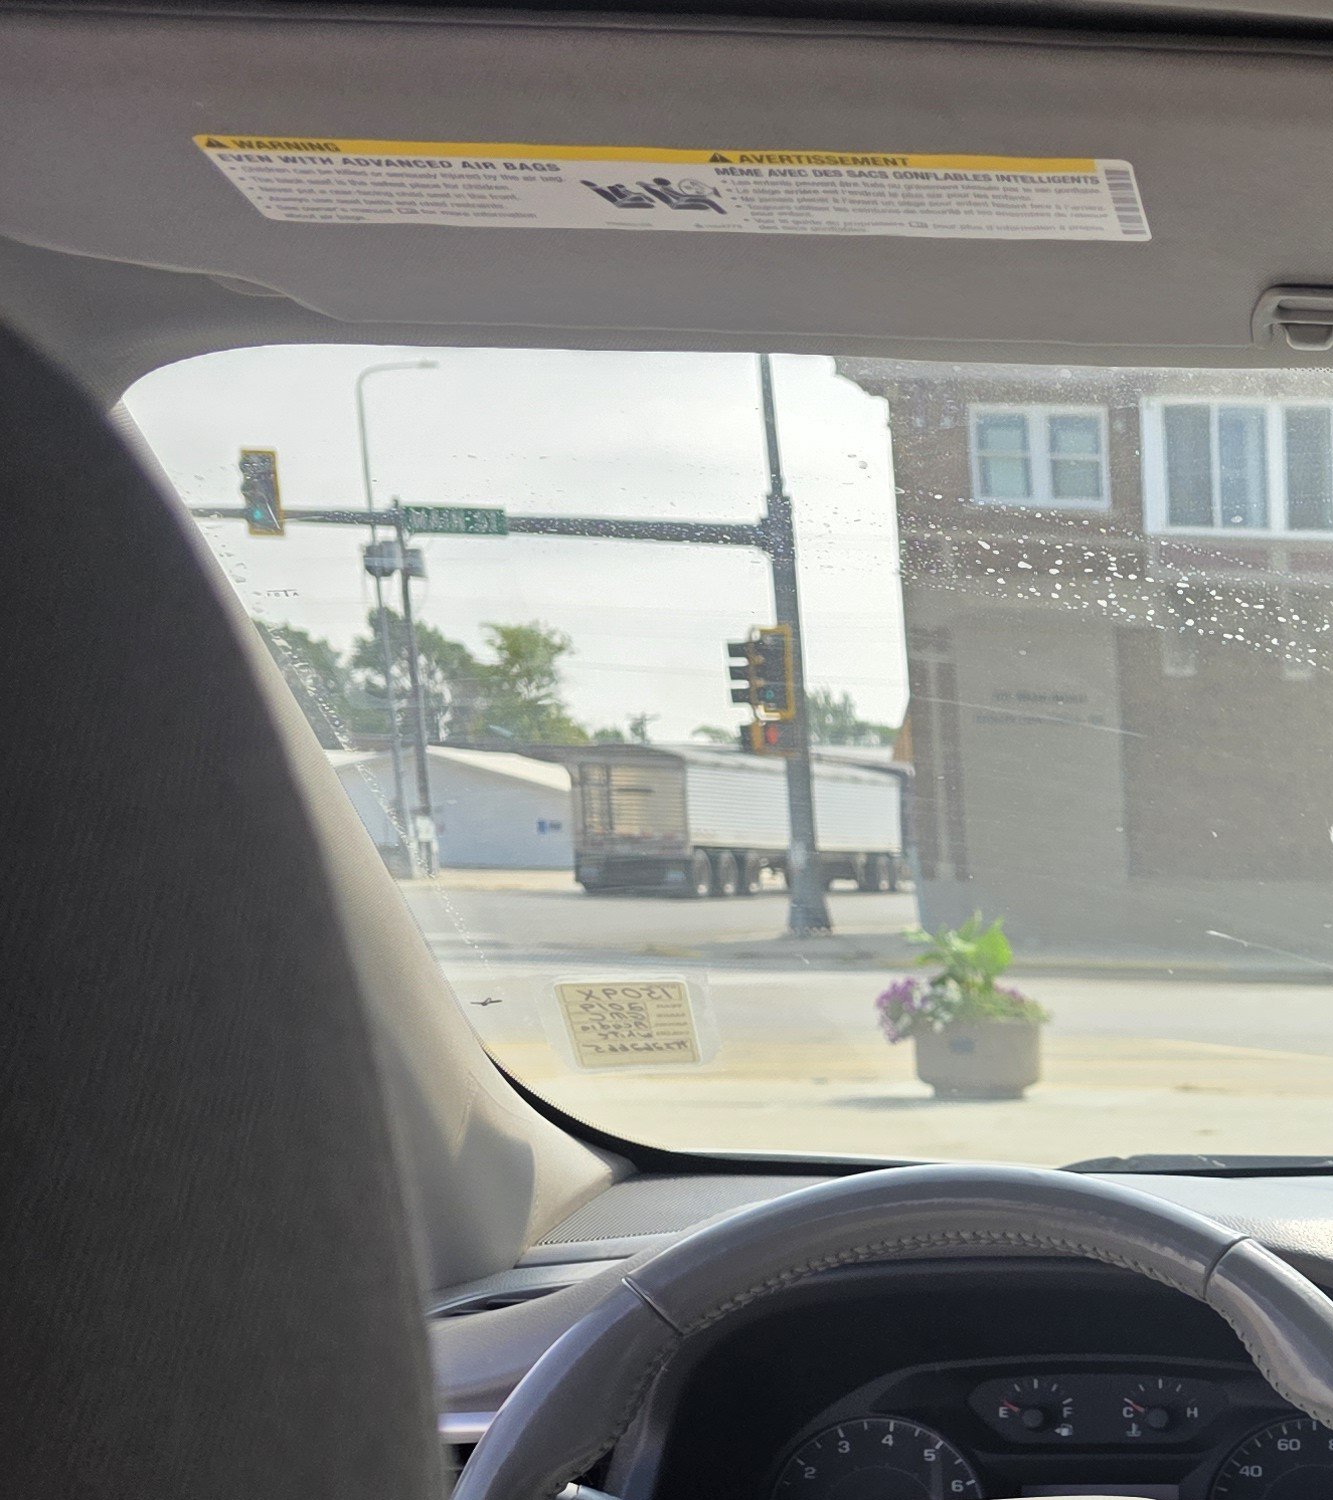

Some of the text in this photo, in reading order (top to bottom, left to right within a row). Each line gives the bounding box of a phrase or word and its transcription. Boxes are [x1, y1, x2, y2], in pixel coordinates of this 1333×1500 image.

[232, 139, 341, 152] WARNING
[218, 153, 561, 172] EVEN WITH ADVANCED AIR BAGS
[738, 153, 910, 167] AVERTISSEMENT
[715, 167, 1100, 185] MÊME AVEC DES SACS GONFLABLES INTELLIGENTS
[998, 1406, 1009, 1418] E
[1062, 1406, 1073, 1418] F
[1122, 1406, 1134, 1419] C
[1186, 1406, 1198, 1418] H
[837, 1440, 851, 1453] 3
[881, 1434, 895, 1447] 4
[1277, 1438, 1300, 1452] 60
[923, 1449, 936, 1462] 5
[804, 1466, 817, 1479] 2
[1239, 1464, 1262, 1478] 40
[951, 1479, 964, 1492] 6
